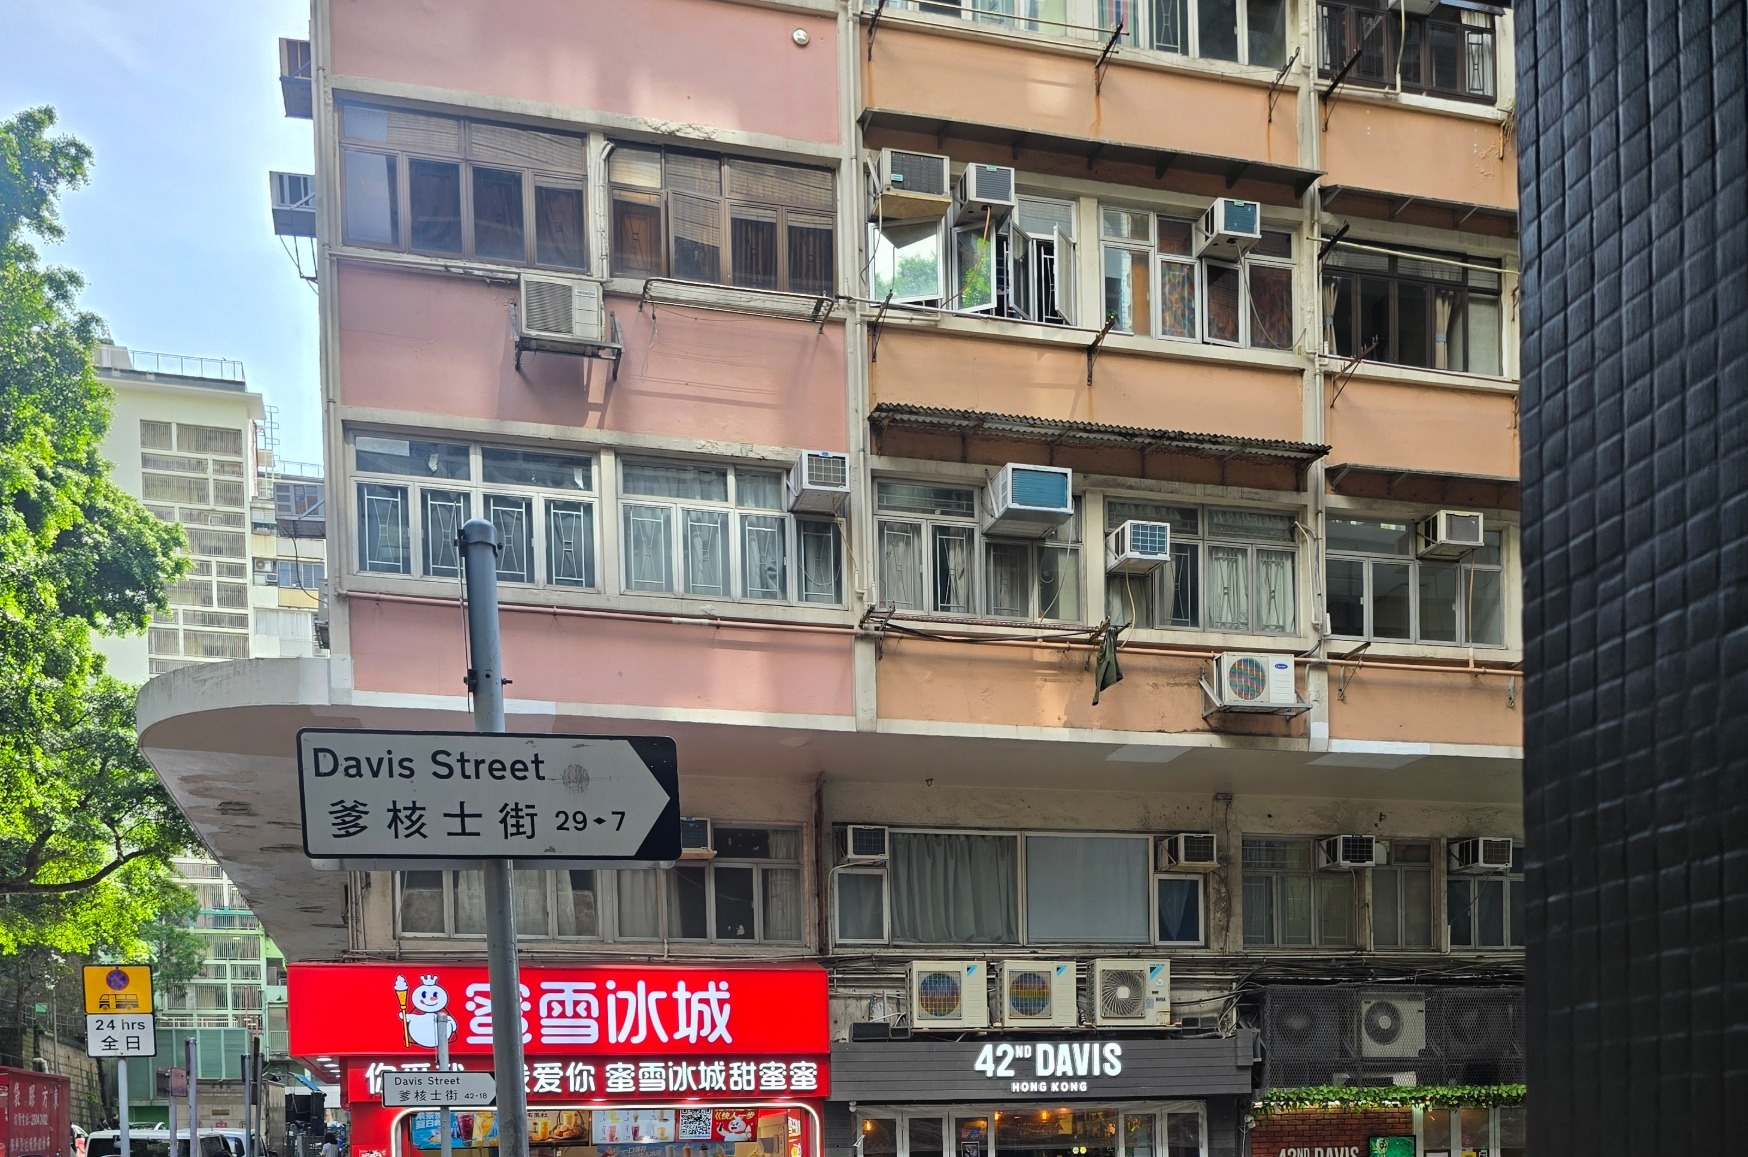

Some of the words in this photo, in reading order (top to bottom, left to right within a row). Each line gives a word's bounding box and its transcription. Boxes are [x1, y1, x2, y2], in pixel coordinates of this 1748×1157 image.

[313, 747, 415, 779] Davis
[430, 749, 546, 781] Street
[328, 799, 538, 840] 爹核士街
[95, 1019, 116, 1031] 24
[121, 1019, 146, 1031] hrs
[101, 1035, 140, 1051] 全日
[1035, 1042, 1123, 1077] DAVIS
[394, 1076, 423, 1086] Davis
[427, 1076, 461, 1086] Street
[605, 1060, 818, 1093] 蜜雪冰城甜蜜蜜
[1011, 1081, 1047, 1092] HONG
[1050, 1081, 1087, 1092] KONG
[464, 1092, 488, 1100] 42-18
